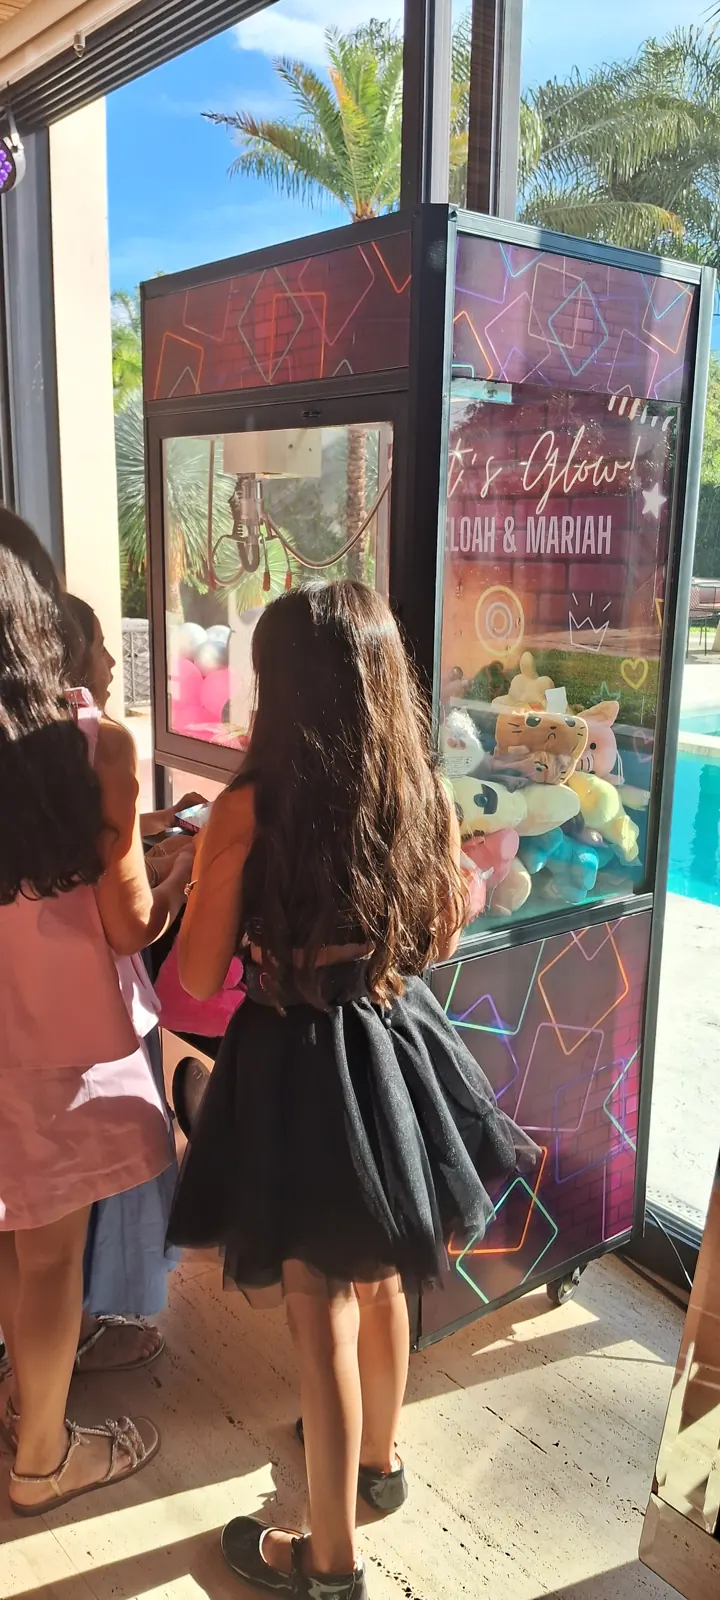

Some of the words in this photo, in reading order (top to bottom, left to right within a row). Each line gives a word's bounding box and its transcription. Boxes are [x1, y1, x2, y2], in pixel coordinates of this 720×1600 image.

[522, 425, 641, 515] Glow!
[503, 516, 517, 553] &
[526, 515, 612, 554] MARIAH
